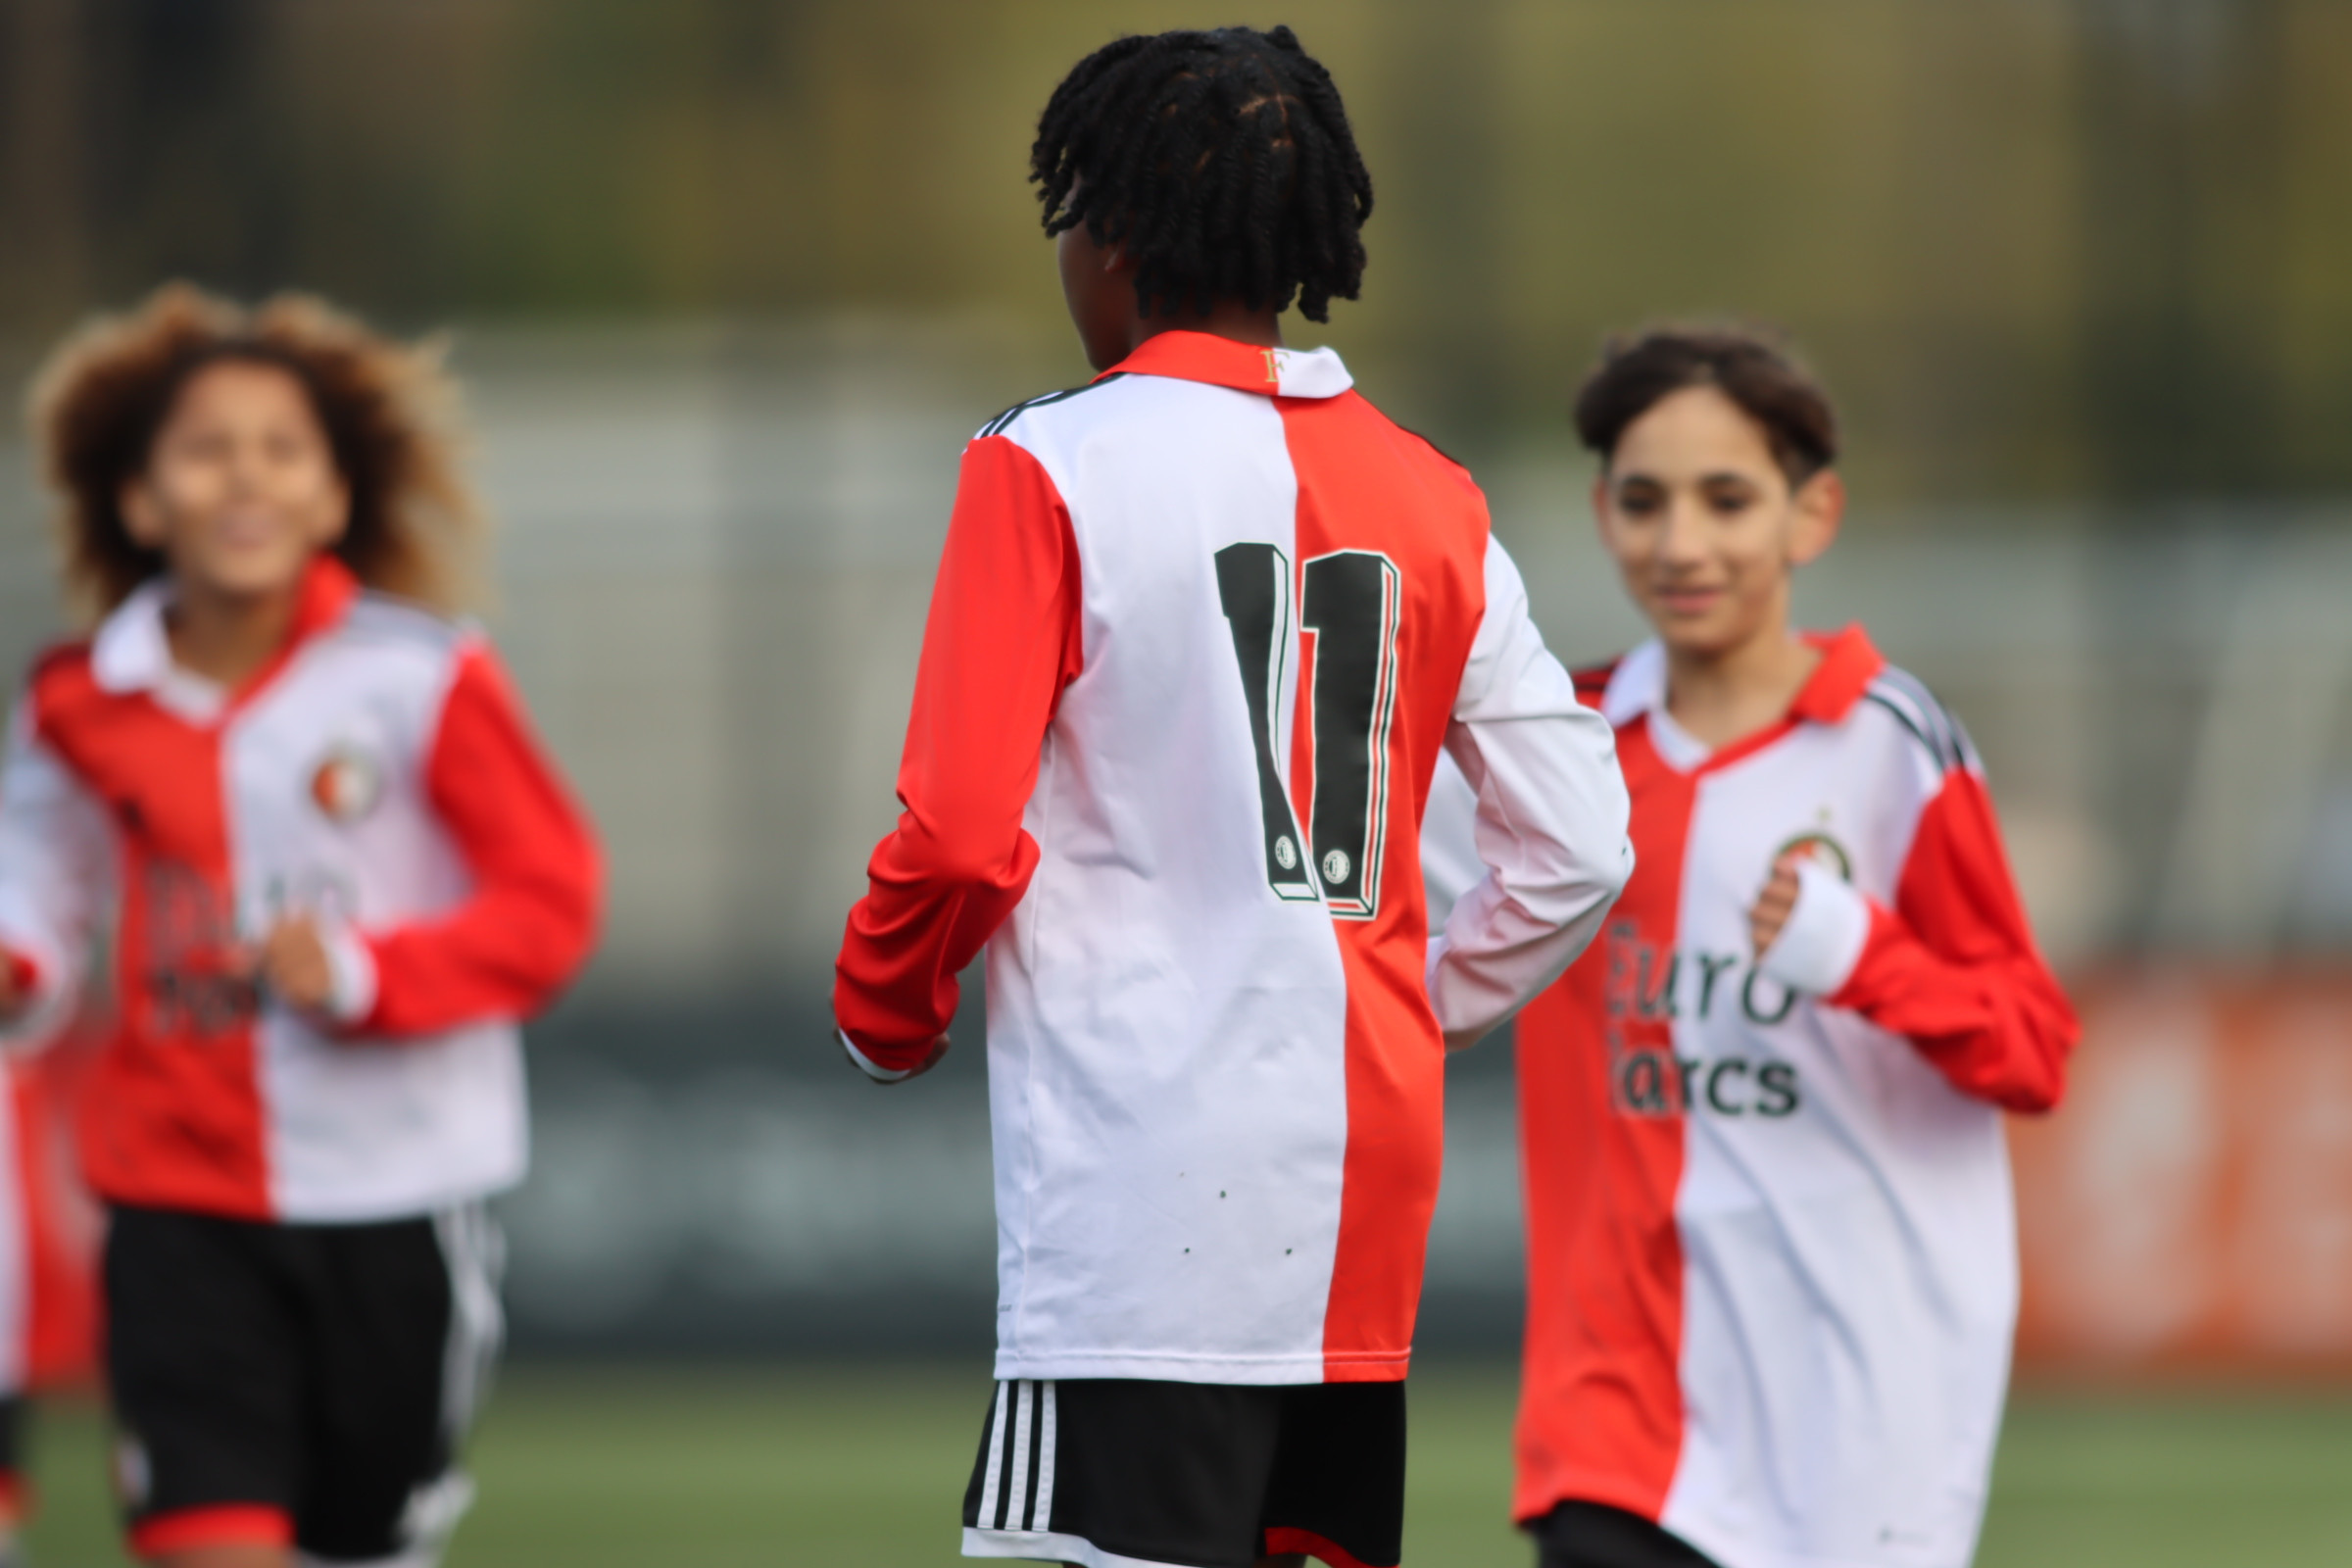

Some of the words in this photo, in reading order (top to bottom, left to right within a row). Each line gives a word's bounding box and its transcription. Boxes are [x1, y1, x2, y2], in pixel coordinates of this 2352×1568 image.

[1259, 349, 1290, 383] F
[1213, 541, 1401, 921] 11
[1609, 1030, 1801, 1115] arcs
